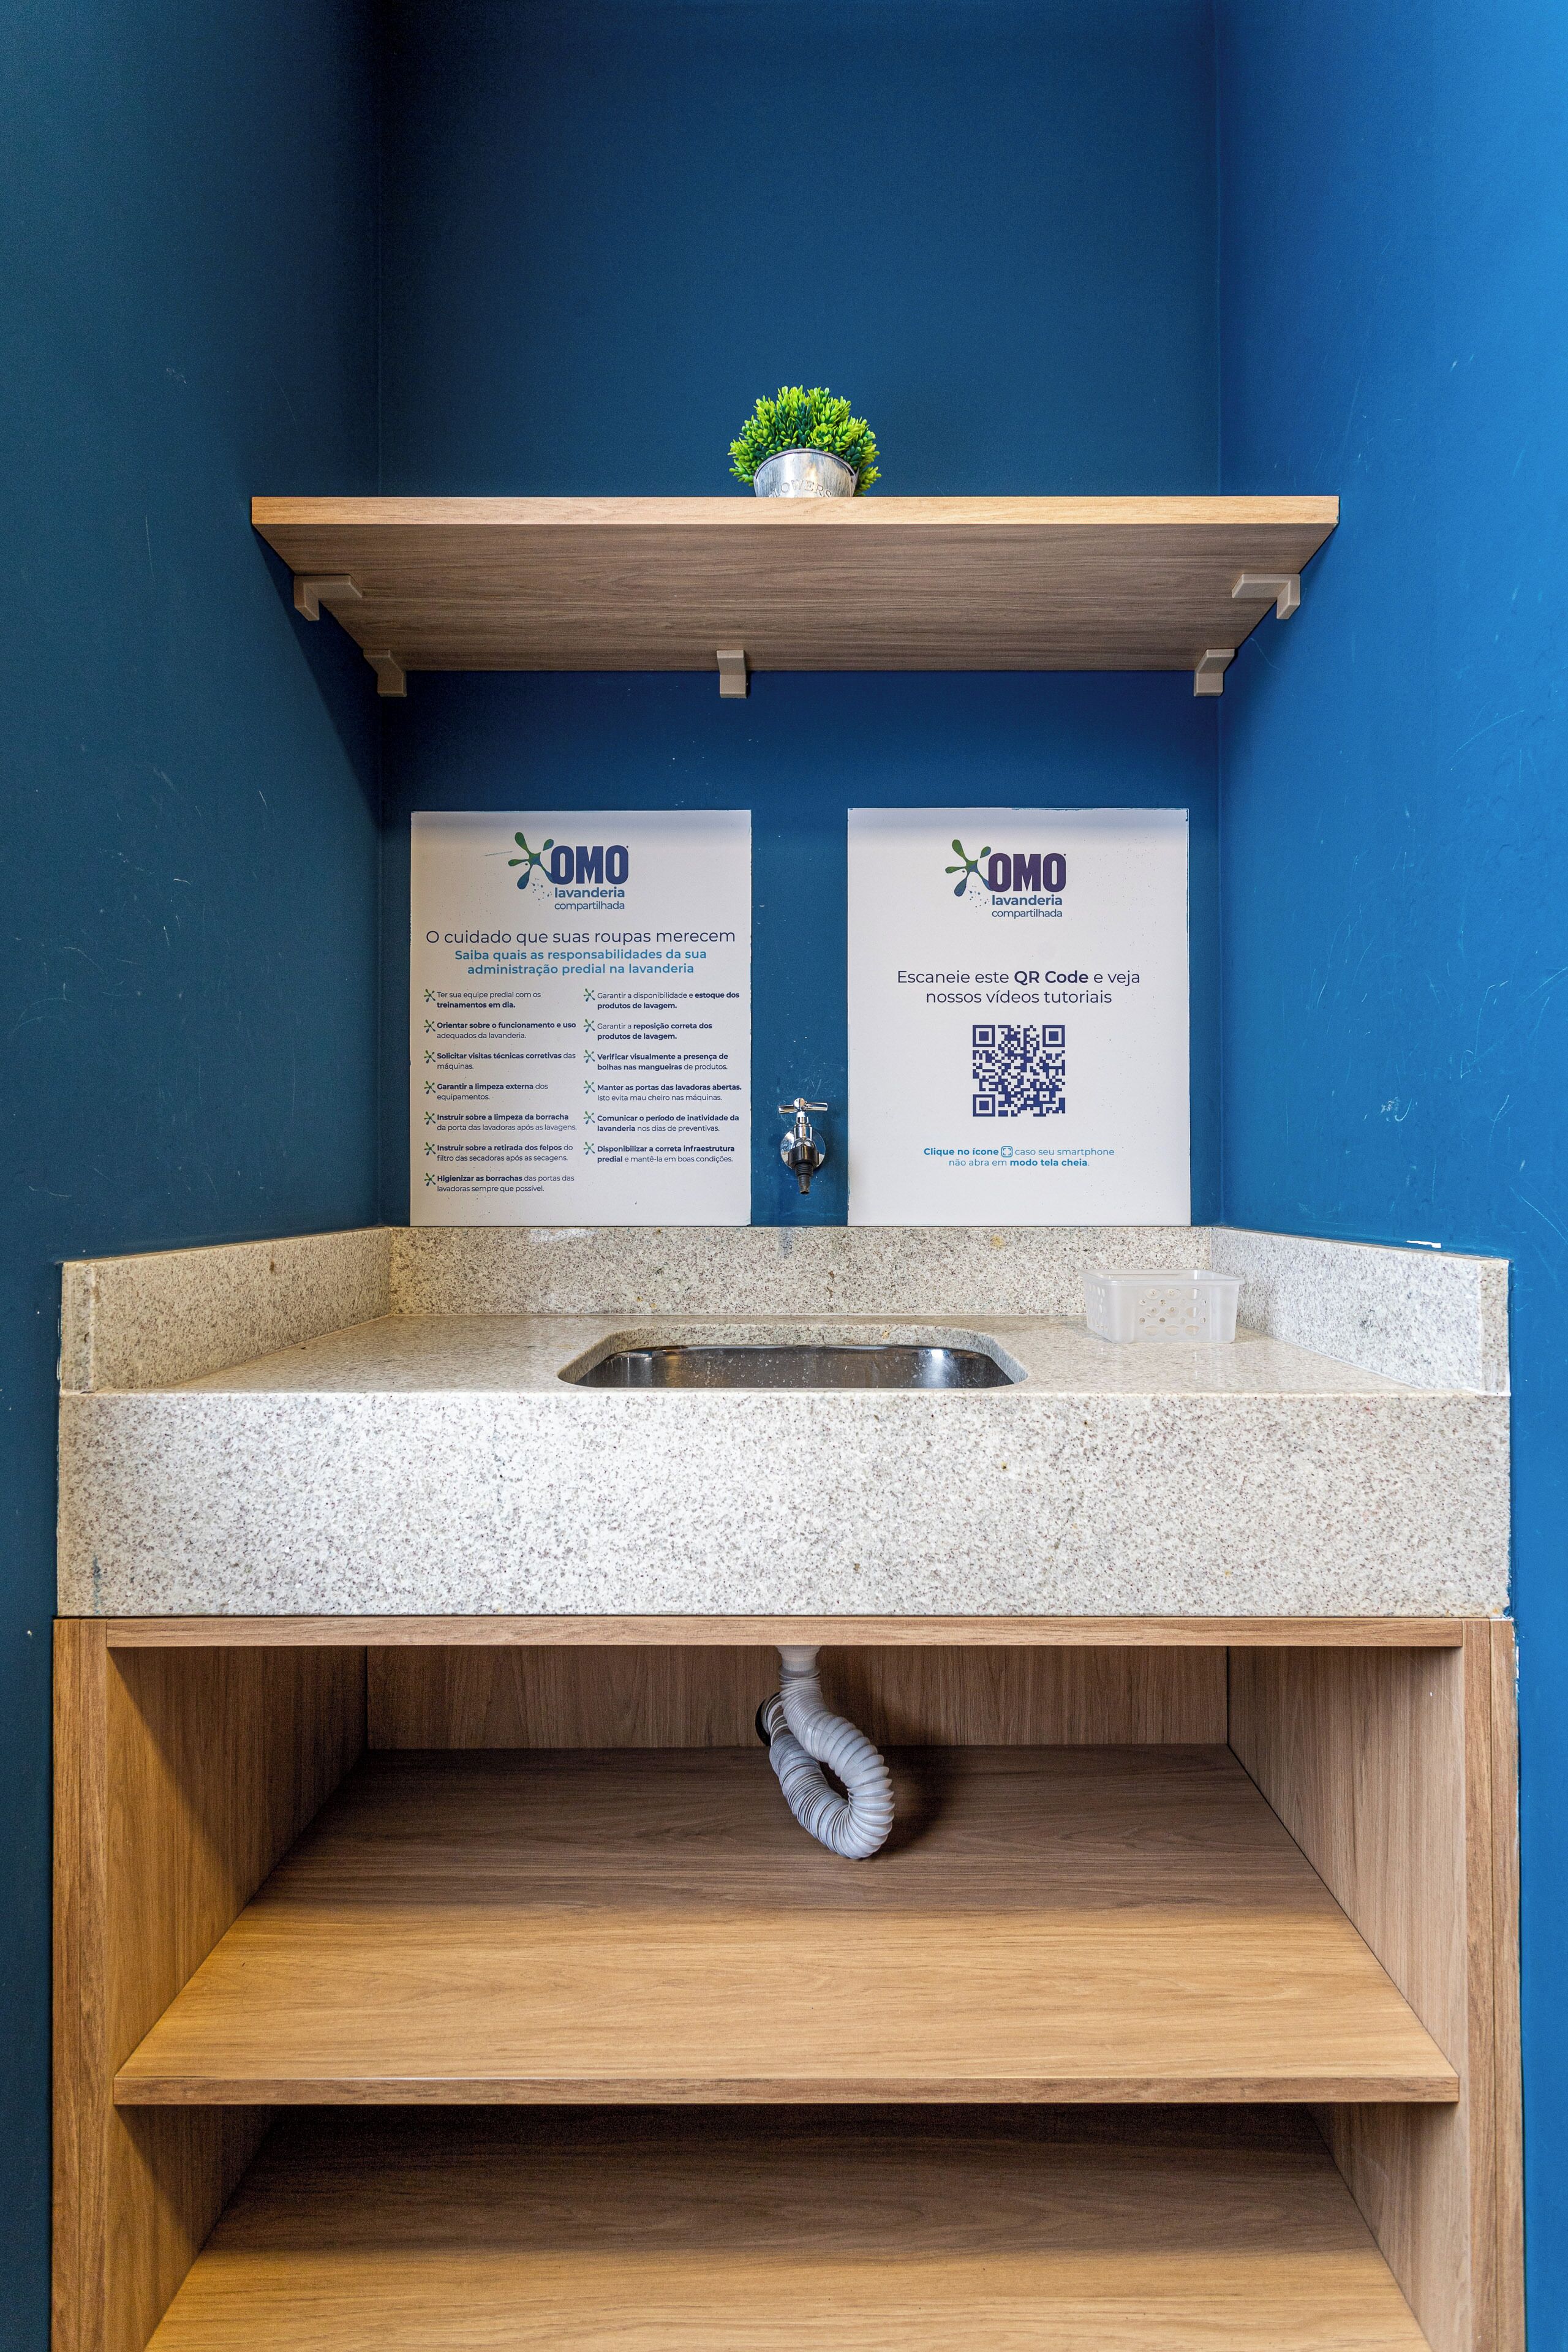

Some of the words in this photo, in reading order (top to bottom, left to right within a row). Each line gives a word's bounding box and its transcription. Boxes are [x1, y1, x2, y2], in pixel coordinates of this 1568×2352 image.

[551, 845, 628, 885] OMO
[988, 853, 1066, 892] OMO
[555, 886, 625, 898] lavanderia
[992, 894, 1062, 905] lavanderia
[554, 900, 625, 911] compartilhada
[992, 908, 1062, 919] compartilhada
[426, 930, 439, 943] O
[443, 929, 511, 943] cuidado
[516, 933, 548, 946] que
[552, 932, 590, 943] suas
[595, 932, 651, 946] roupas
[657, 932, 735, 942] merecem
[454, 948, 489, 960] Saiba
[493, 949, 527, 962] quais
[530, 951, 544, 960] as
[548, 948, 662, 962] responsabilidades
[666, 948, 681, 959] da
[467, 963, 558, 976] administração
[562, 963, 605, 976] predial
[629, 962, 693, 973] lavanderia
[898, 970, 970, 983] Escaneie
[975, 971, 1009, 983] este
[1014, 970, 1039, 986] QR
[1045, 970, 1088, 983] Code
[1094, 973, 1103, 983] e
[1107, 970, 1139, 987] veja
[463, 990, 488, 999] equipe
[927, 993, 982, 1003] nossos
[986, 989, 1039, 1003] vídeos
[1044, 989, 1112, 1003] tutoriais
[633, 1022, 669, 1031] reposição
[437, 1031, 477, 1040] adequados
[638, 1063, 682, 1071] mangueiras
[437, 1093, 490, 1101] equipamentos.
[597, 1145, 647, 1153] Disponibilizar
[924, 1147, 954, 1156] Clique
[1057, 1147, 1115, 1157] smartphone
[949, 1157, 966, 1166] não
[1061, 1158, 1090, 1166] cheia.
[437, 1174, 474, 1183] Higienizar
